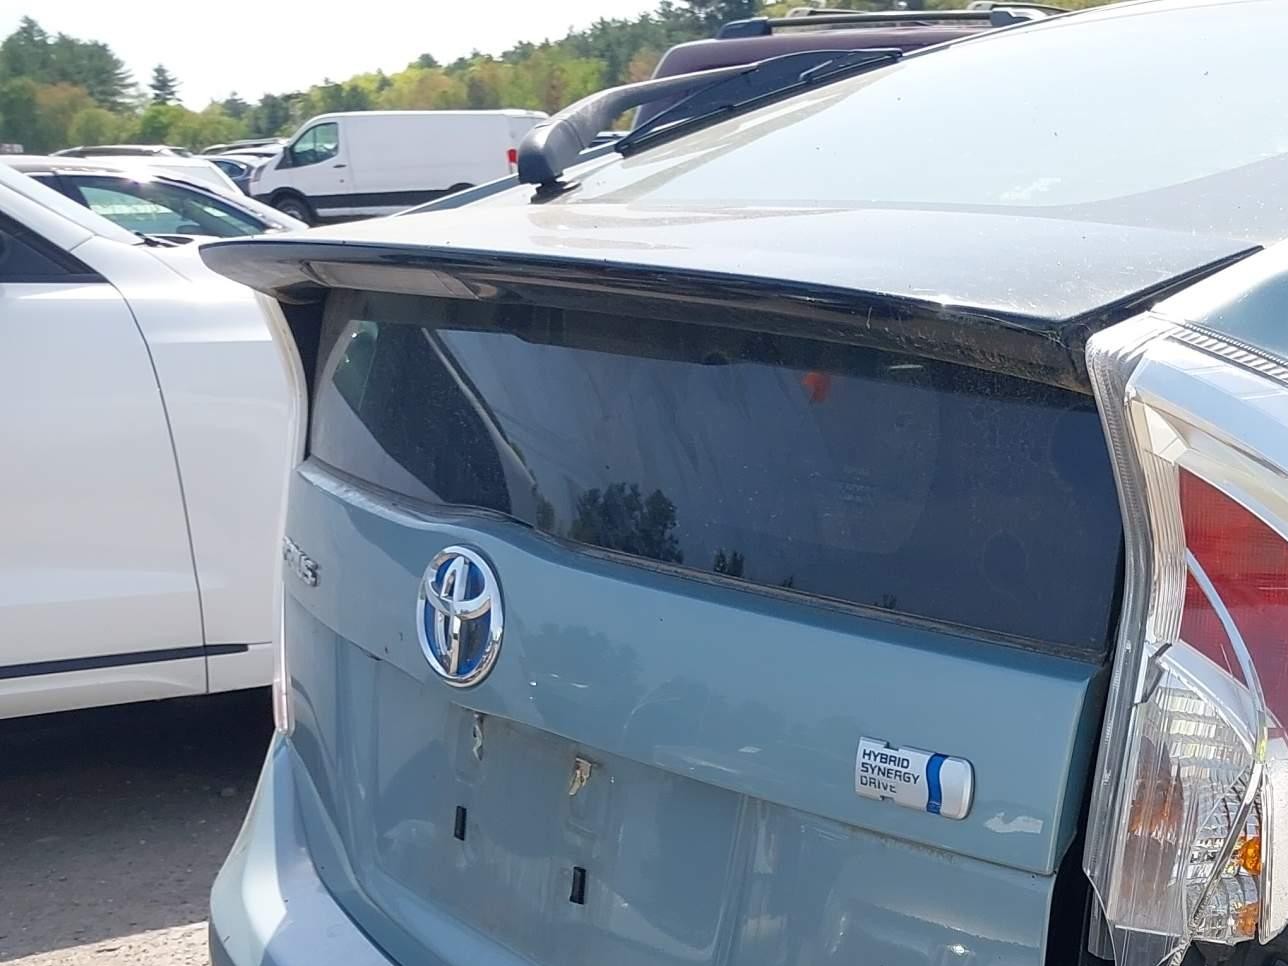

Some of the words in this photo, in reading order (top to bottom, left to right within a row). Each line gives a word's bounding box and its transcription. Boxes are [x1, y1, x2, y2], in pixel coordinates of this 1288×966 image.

[862, 748, 910, 769] HYBRID
[860, 762, 921, 785] SYNERGY
[860, 775, 897, 794] DRIVE
